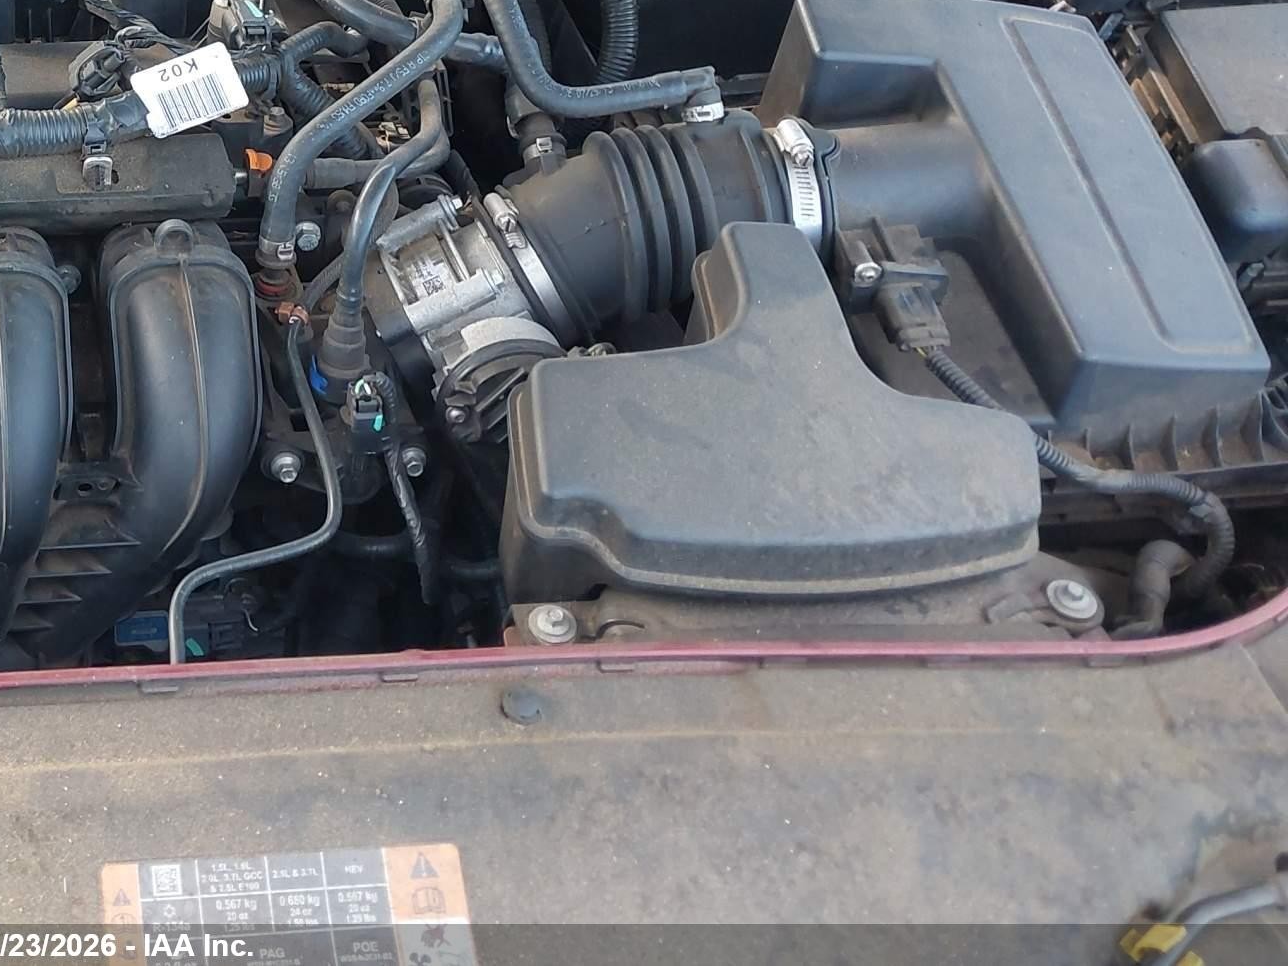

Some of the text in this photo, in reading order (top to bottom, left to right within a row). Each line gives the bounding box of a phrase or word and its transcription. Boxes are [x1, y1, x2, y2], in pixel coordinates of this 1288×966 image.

[158, 57, 199, 83] K02
[243, 870, 263, 880] GCC
[307, 894, 320, 907] kg
[365, 890, 378, 903] kg
[216, 898, 257, 911] 0.567 kg
[226, 912, 237, 921] 20
[259, 946, 285, 960] PAG
[353, 941, 379, 953] POE
